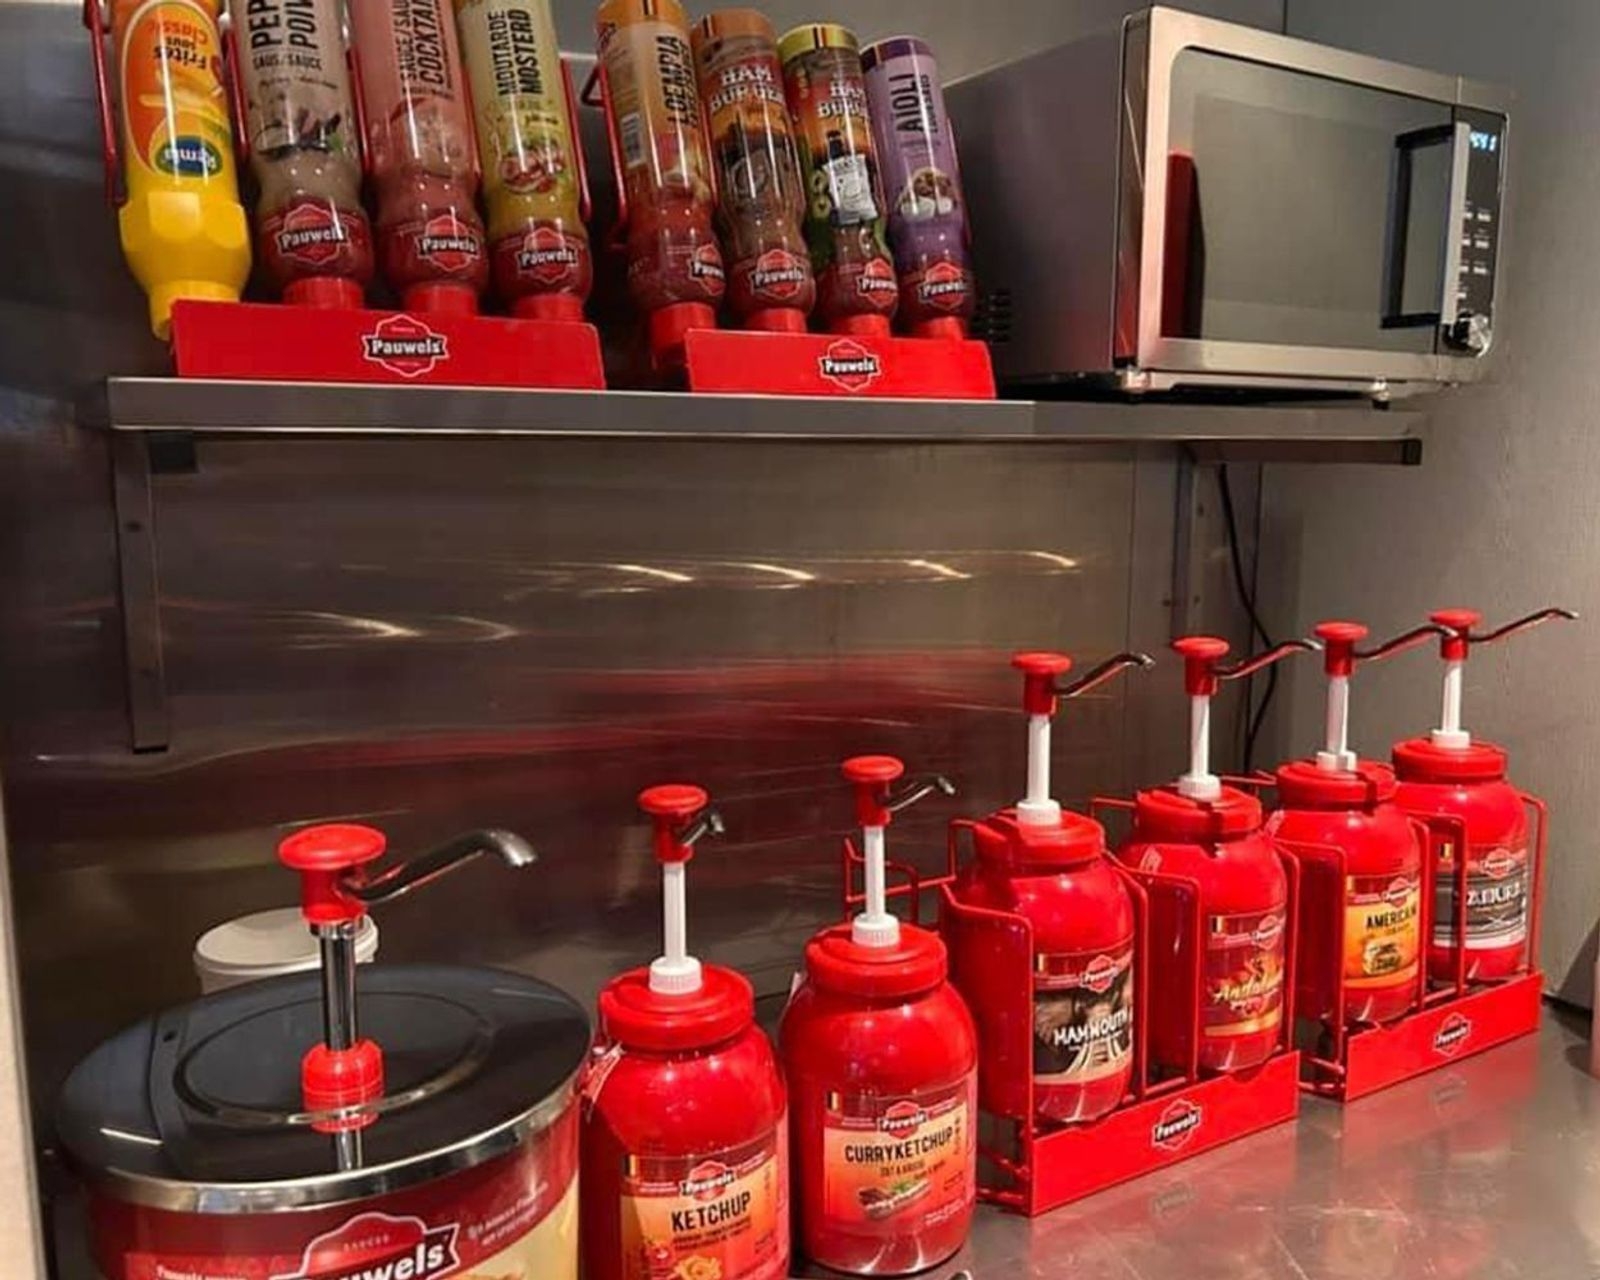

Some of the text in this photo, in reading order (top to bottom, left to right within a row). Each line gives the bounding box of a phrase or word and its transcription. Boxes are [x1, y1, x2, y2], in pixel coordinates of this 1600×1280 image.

[488, 10, 516, 96] MOUTARDE
[507, 9, 543, 94] MOSTERD
[722, 65, 774, 87] HAM
[422, 233, 475, 252] Pauwels
[372, 338, 440, 354] Pauwels
[825, 357, 875, 373] Pauwels
[1366, 904, 1418, 928] AMERICAN
[880, 1110, 928, 1131] Pauwels
[844, 1126, 953, 1164] CURRYKETCHUP
[671, 1190, 751, 1233] KETCHUP
